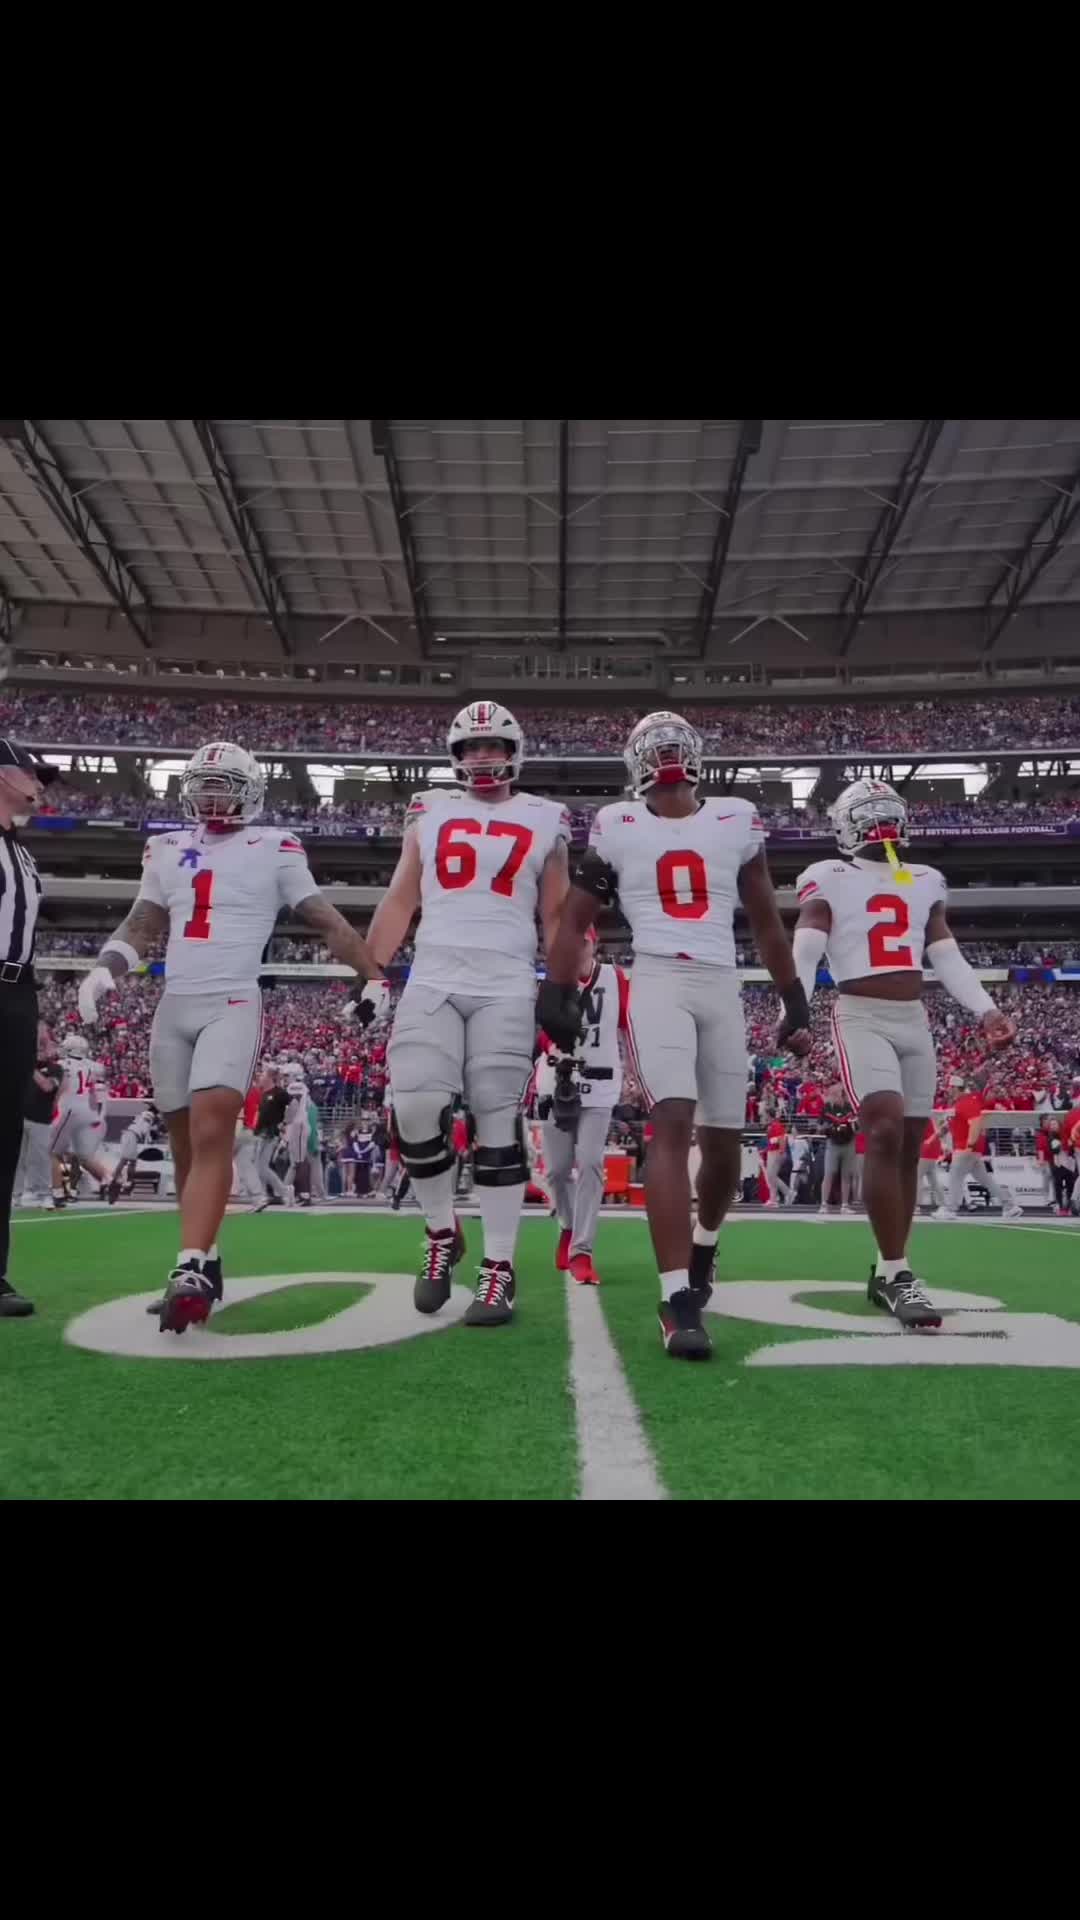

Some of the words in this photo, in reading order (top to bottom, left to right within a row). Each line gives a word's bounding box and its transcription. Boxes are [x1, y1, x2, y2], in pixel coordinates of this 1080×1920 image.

[436, 818, 533, 897] 67
[656, 849, 709, 920] 0
[183, 869, 214, 940] 1
[866, 894, 913, 968] 2
